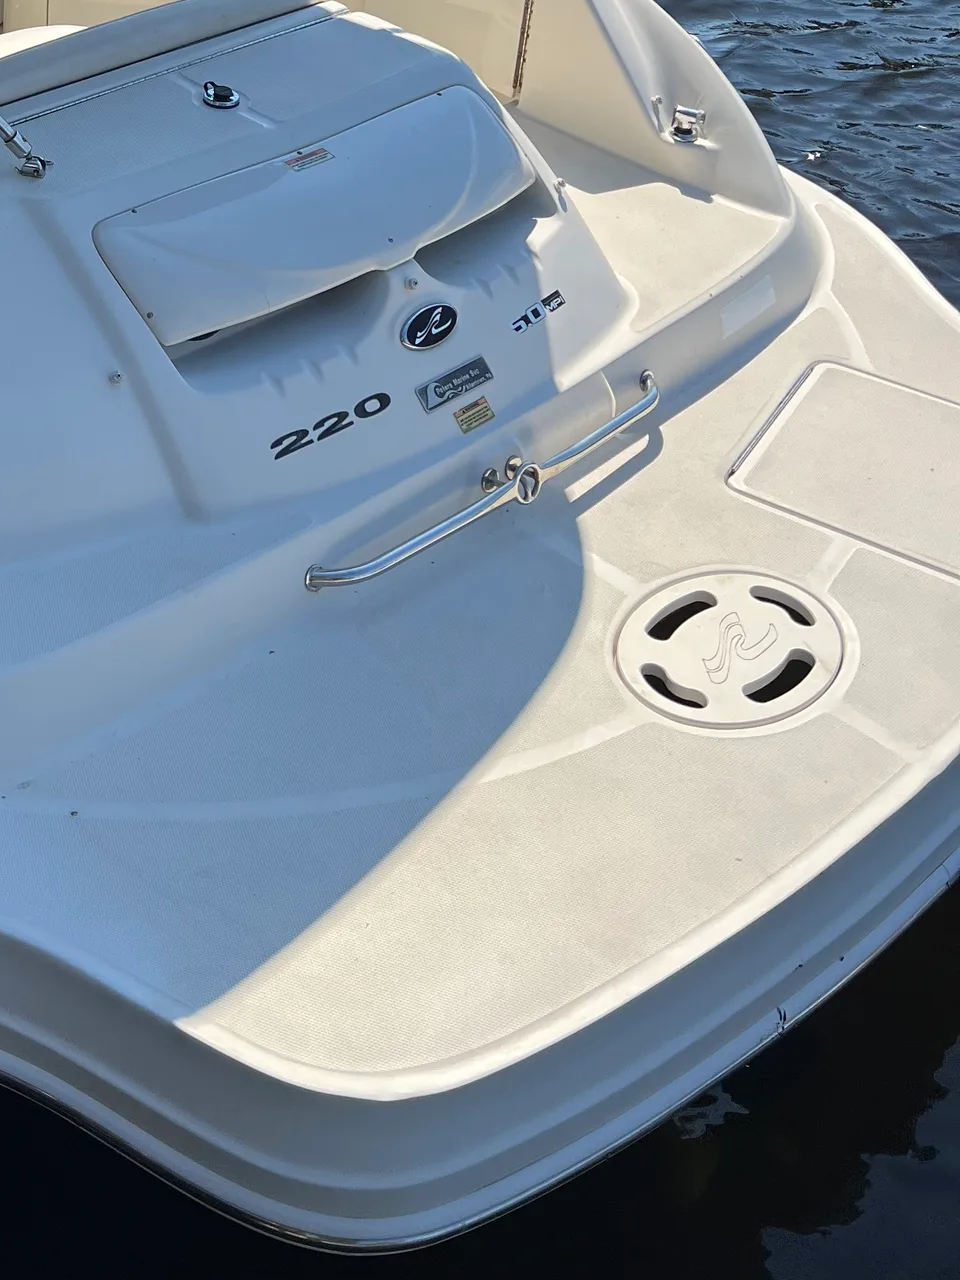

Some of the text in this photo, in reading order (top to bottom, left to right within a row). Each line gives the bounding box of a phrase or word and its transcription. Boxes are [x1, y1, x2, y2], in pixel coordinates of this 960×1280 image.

[509, 302, 546, 334] 5.0
[545, 296, 565, 312] MPI
[270, 393, 391, 460] 220
